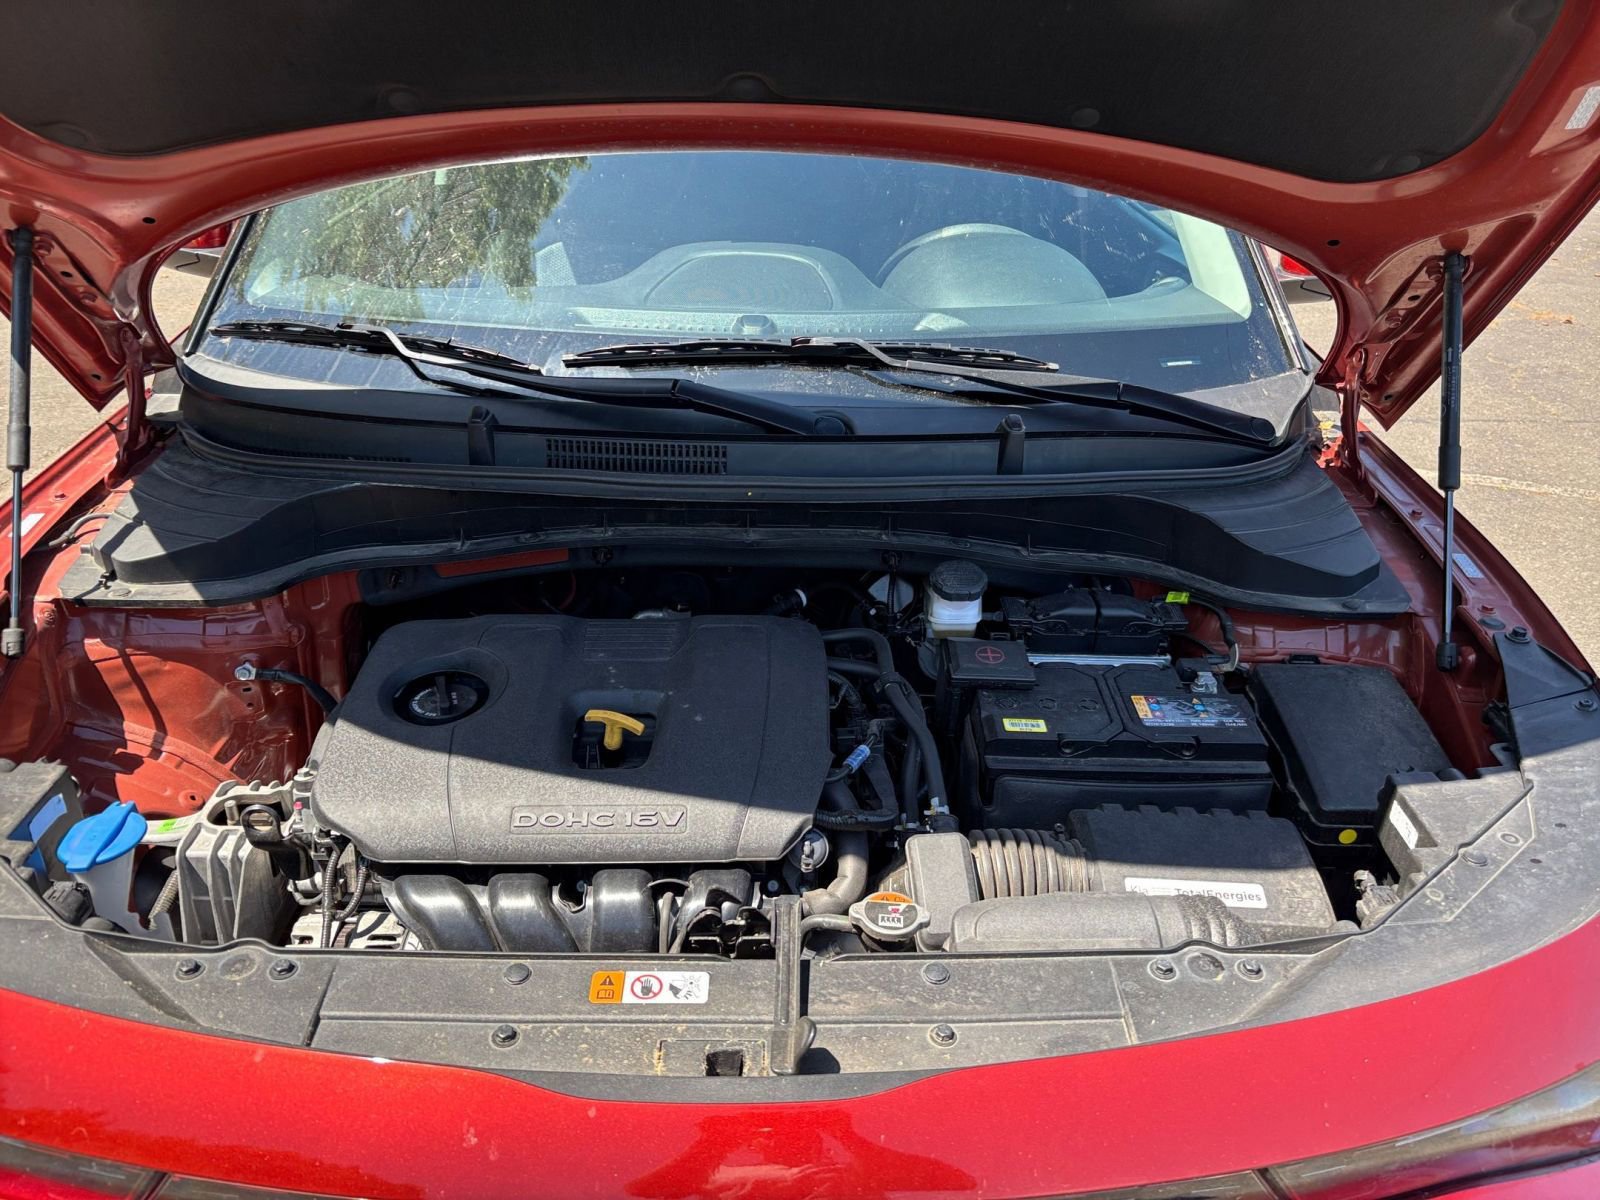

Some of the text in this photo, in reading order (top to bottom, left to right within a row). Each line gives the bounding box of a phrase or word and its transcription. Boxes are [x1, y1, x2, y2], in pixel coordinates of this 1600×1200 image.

[513, 811, 685, 828] DOHC 16V
[1174, 887, 1262, 902] TotalEnergies
